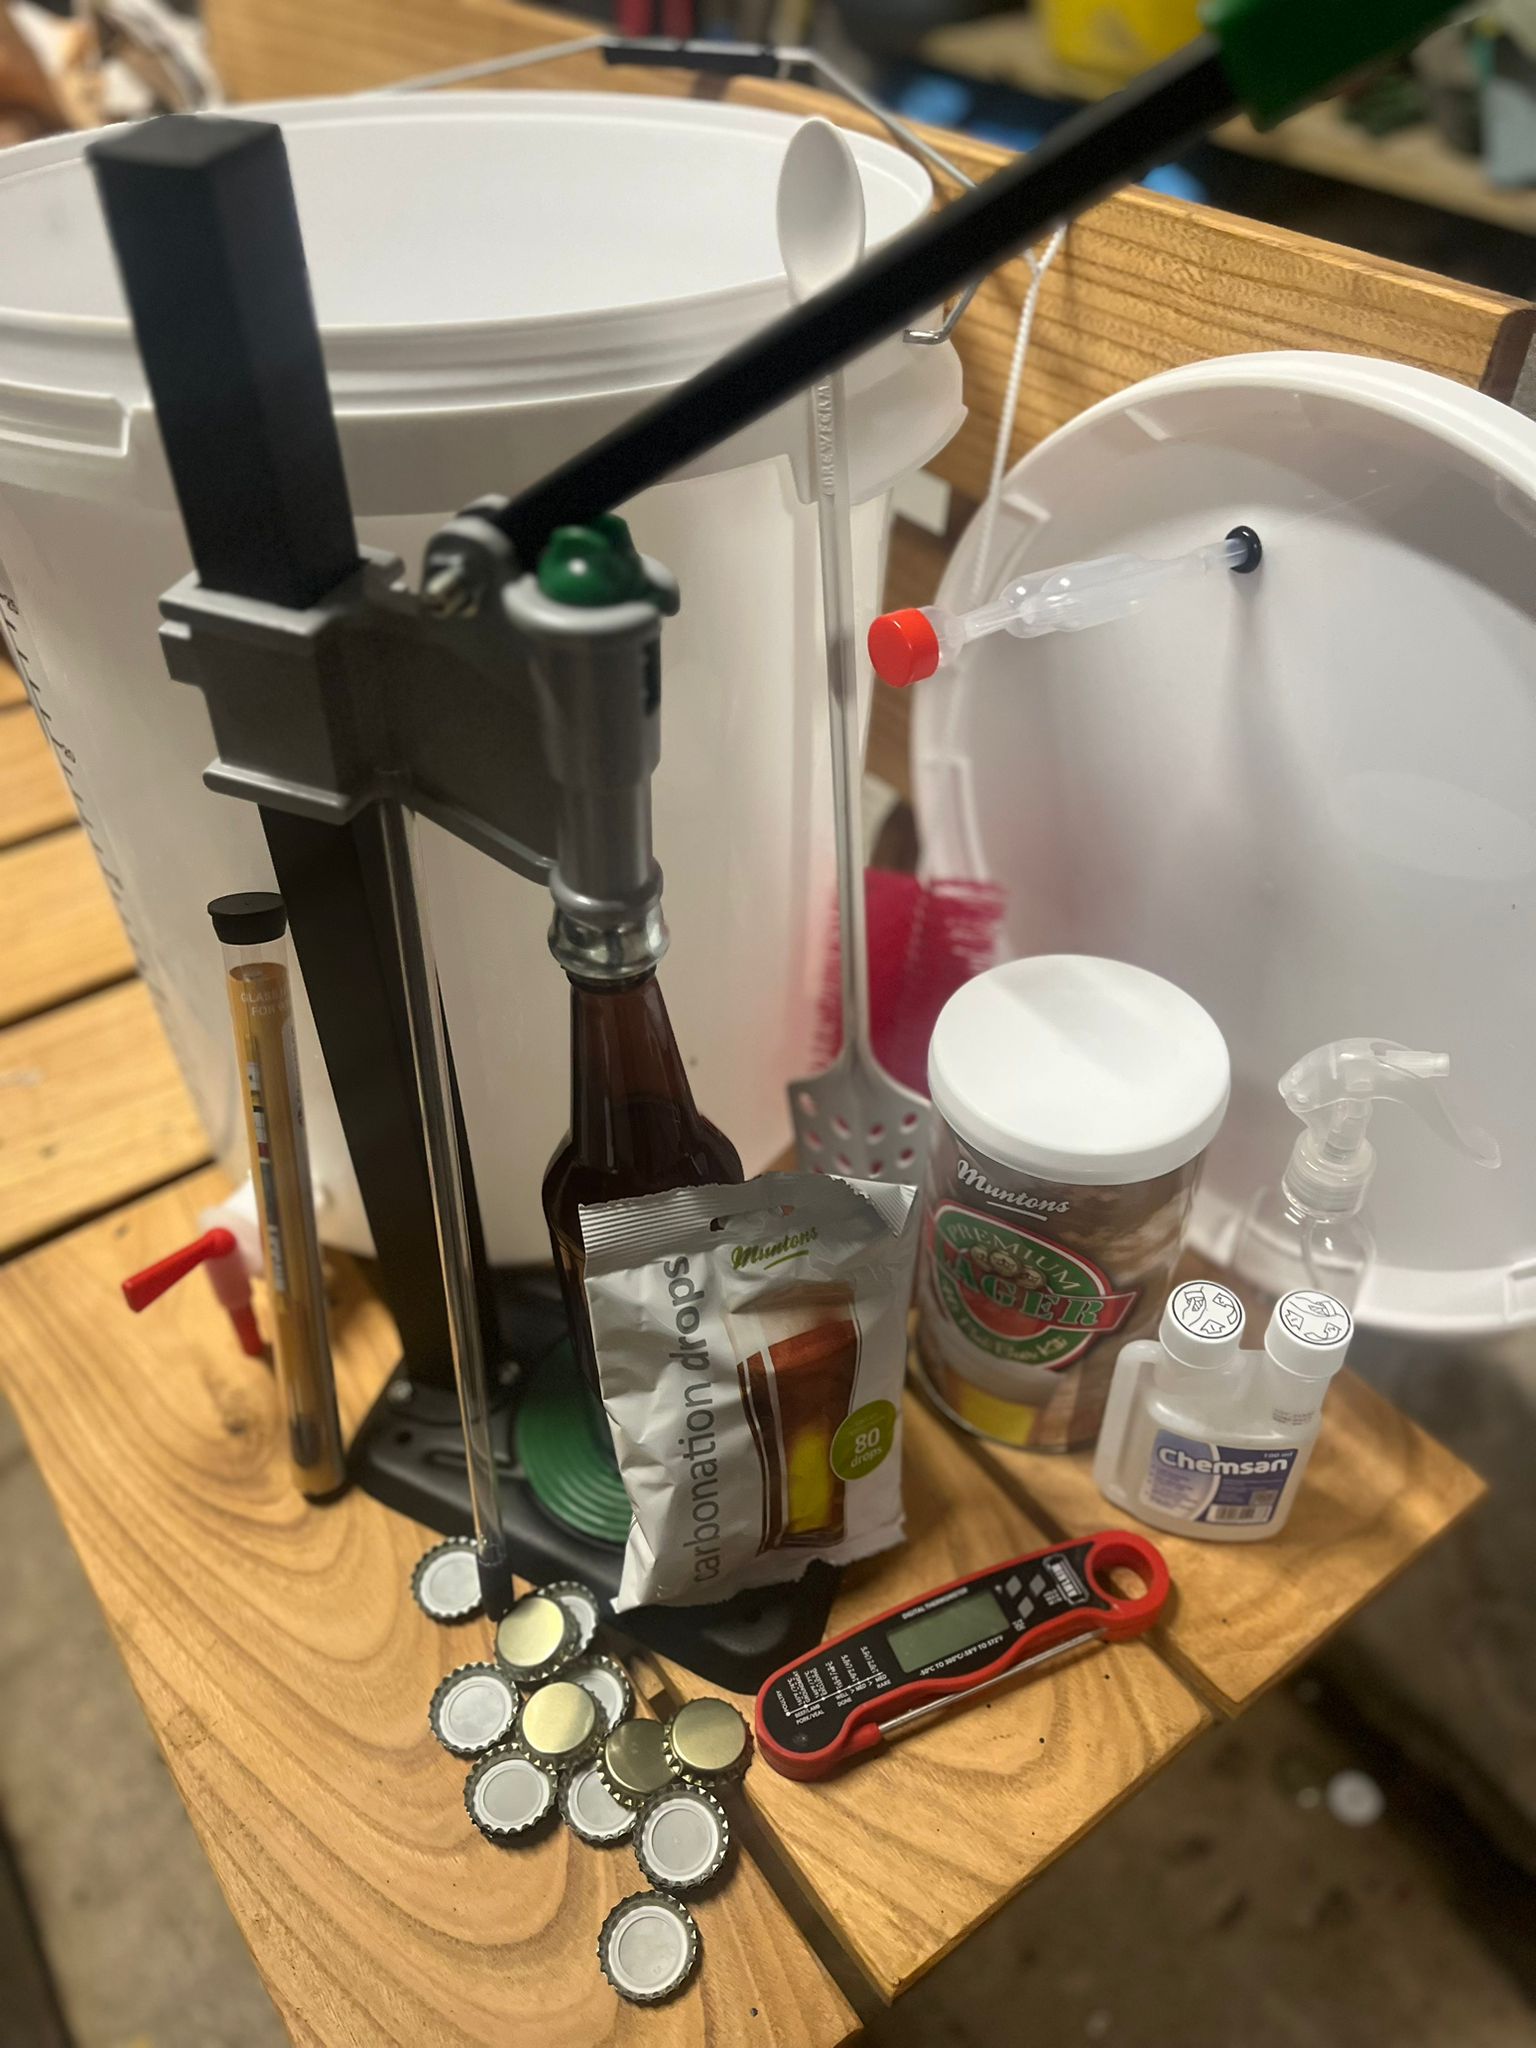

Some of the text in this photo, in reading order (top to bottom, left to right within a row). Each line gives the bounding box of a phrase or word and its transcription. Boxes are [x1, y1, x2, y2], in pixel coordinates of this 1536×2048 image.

[957, 1159, 1070, 1213] Muntons
[731, 1226, 819, 1270] Muntons
[946, 1222, 1081, 1290] PREMIUM
[663, 1255, 722, 1584] carbonation drops
[855, 1427, 880, 1454] 80
[850, 1446, 883, 1468] drops
[1157, 1446, 1289, 1477] Chemsan
